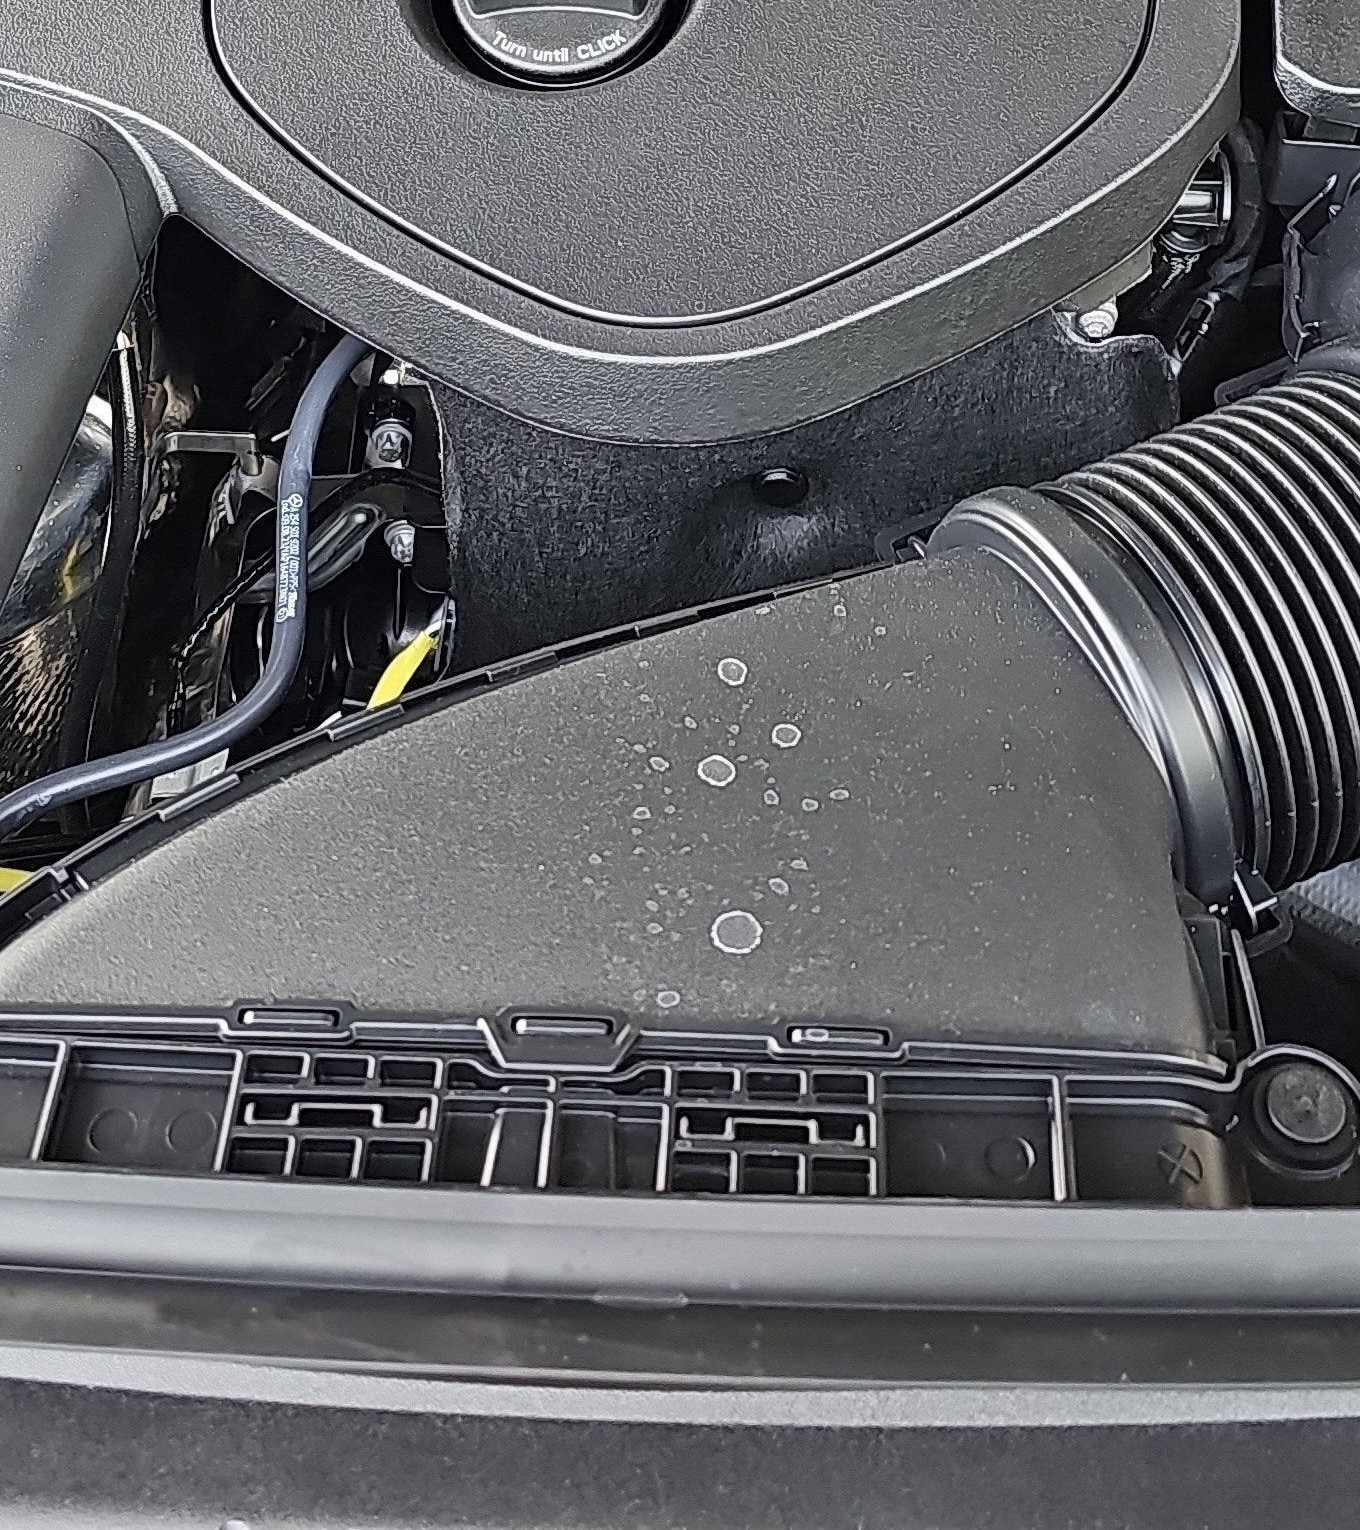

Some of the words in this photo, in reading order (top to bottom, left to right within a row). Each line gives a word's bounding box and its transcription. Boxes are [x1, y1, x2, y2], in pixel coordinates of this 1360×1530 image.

[491, 30, 528, 58] Turn
[532, 47, 570, 63] until
[576, 29, 628, 60] CLICK
